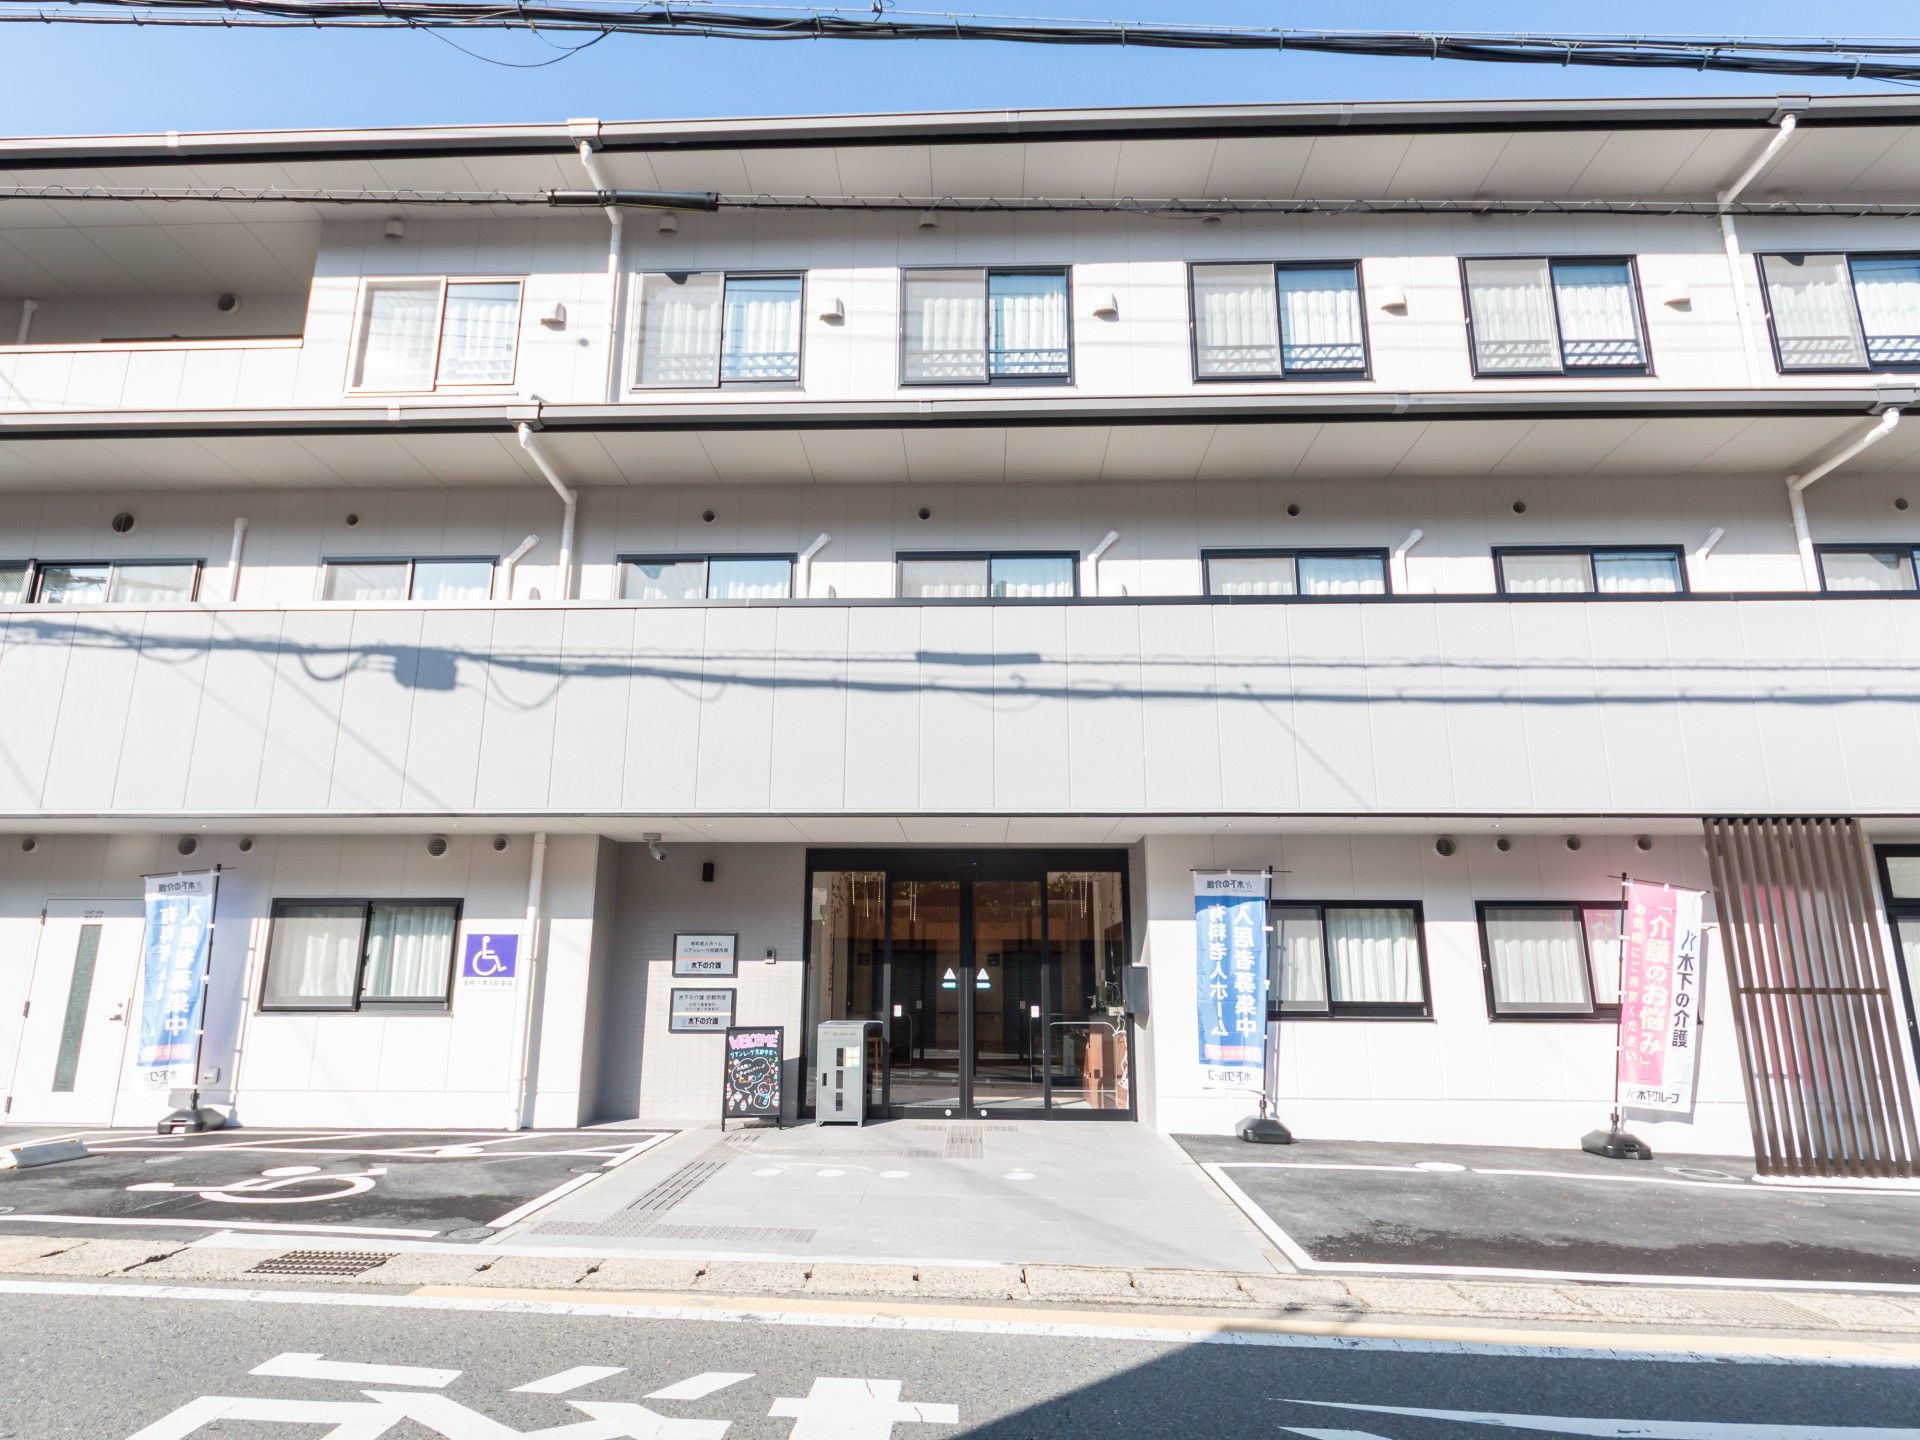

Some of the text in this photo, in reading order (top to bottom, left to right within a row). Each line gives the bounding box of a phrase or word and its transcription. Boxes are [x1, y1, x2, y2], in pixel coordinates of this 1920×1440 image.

[690, 961, 722, 969] 木下の介護
[1671, 952, 1695, 1049] 木下の介護
[687, 1017, 719, 1025] 木下の介護
[728, 1033, 778, 1050] WELCOME
[1636, 1089, 1680, 1104] 木下グループ
